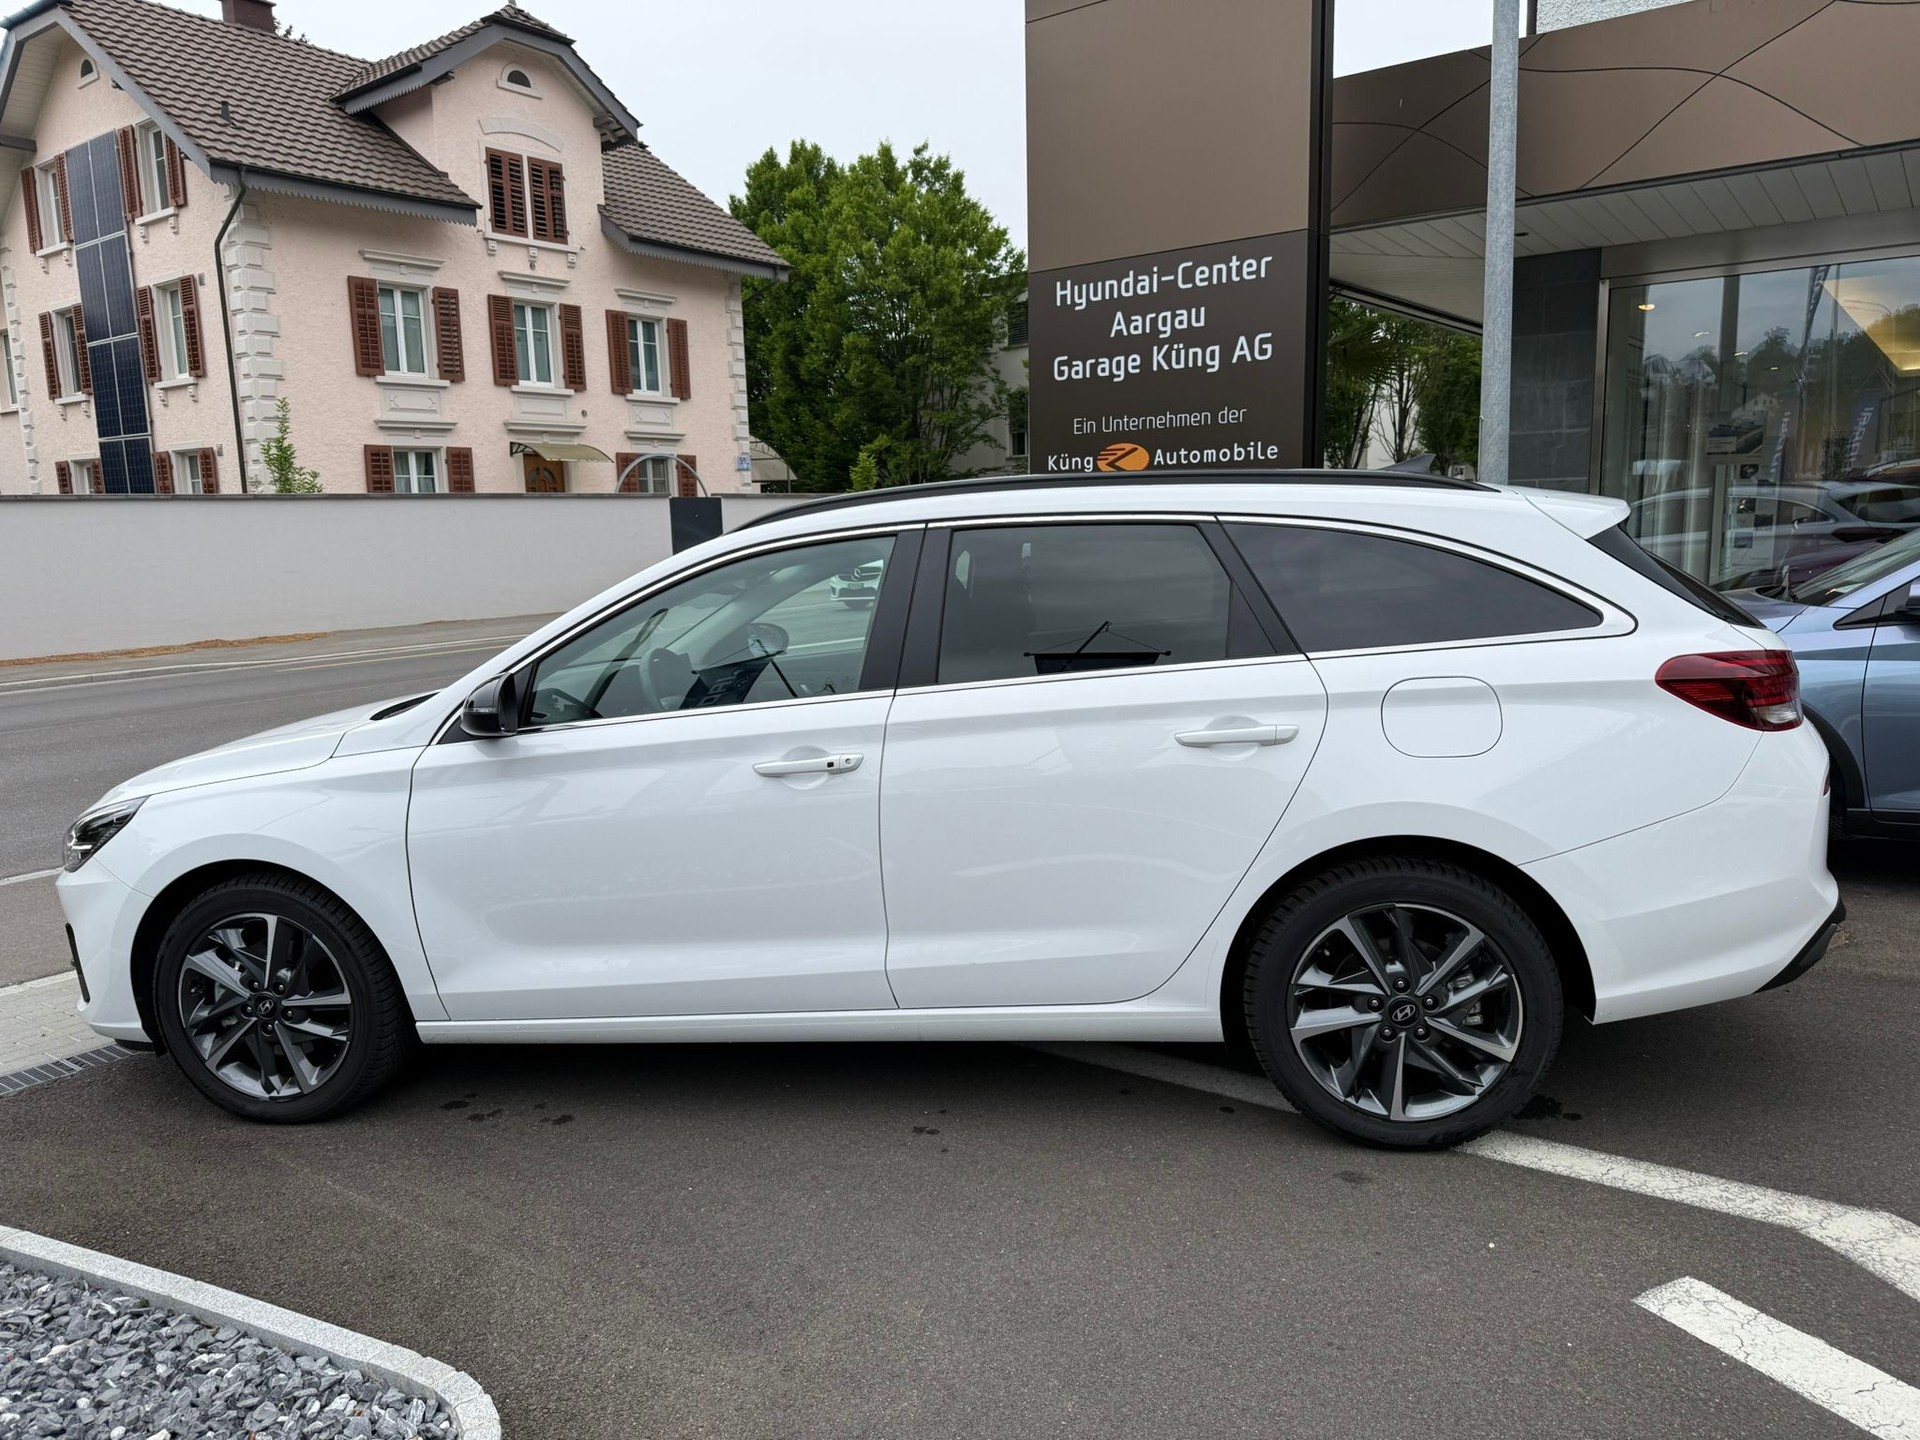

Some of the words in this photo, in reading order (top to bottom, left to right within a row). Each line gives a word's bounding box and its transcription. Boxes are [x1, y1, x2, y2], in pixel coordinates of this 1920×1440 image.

[1056, 255, 1273, 311] Hyundai-Center
[1110, 306, 1206, 338] Aargau
[1053, 353, 1141, 382] Garage
[1152, 343, 1220, 373] Küng
[1231, 332, 1273, 363] AG
[1073, 418, 1096, 434] Ein
[1102, 411, 1211, 433] Unternehmen
[1218, 406, 1247, 424] der
[1048, 453, 1094, 472] Küng
[1153, 441, 1279, 466] Automobile
